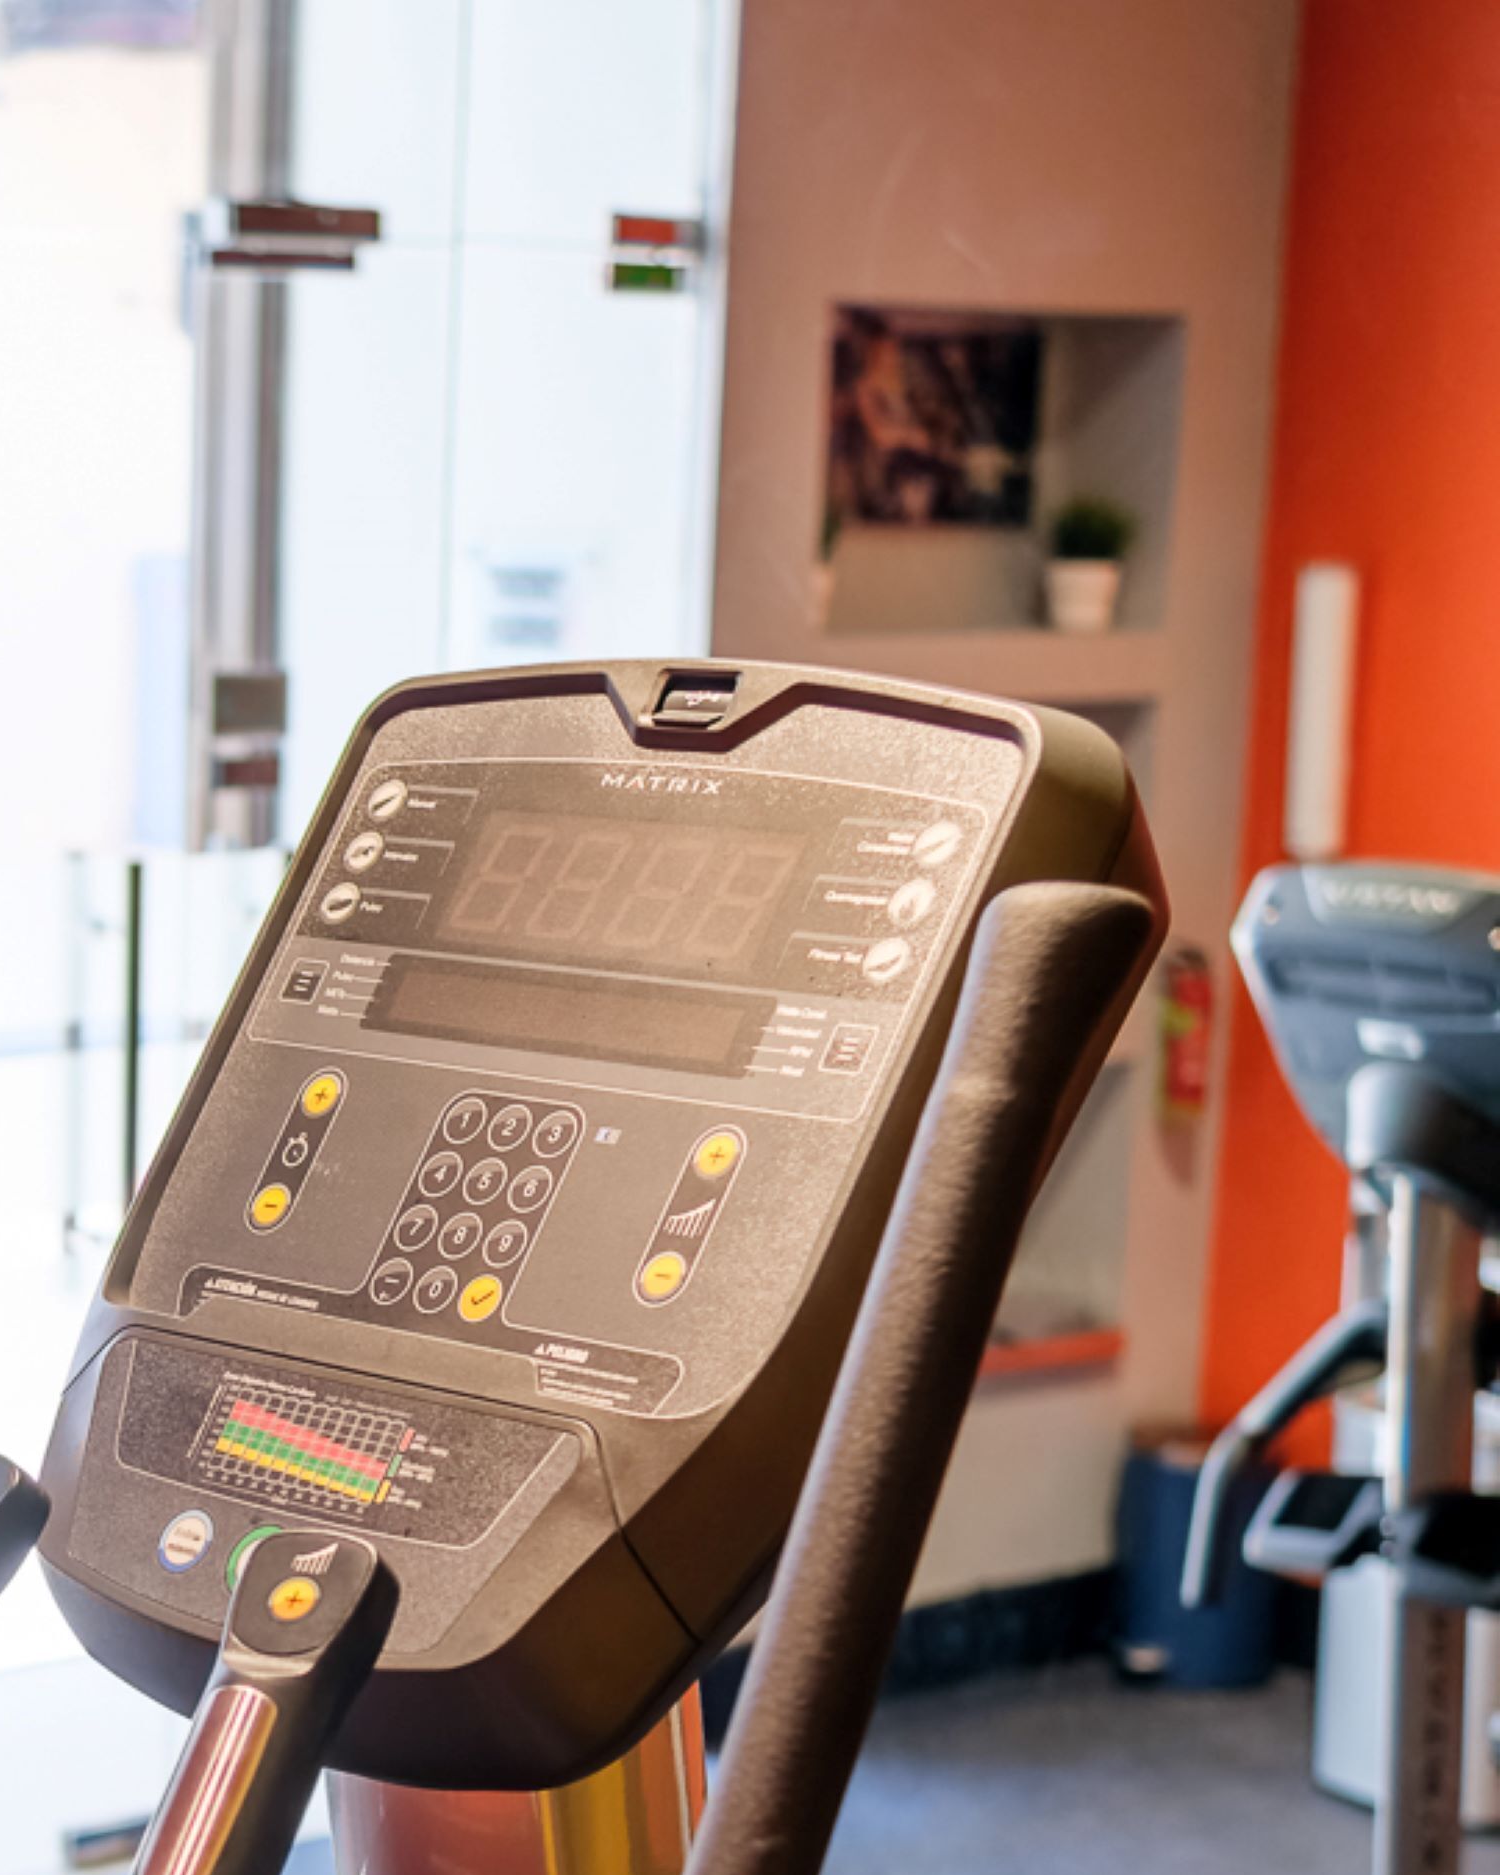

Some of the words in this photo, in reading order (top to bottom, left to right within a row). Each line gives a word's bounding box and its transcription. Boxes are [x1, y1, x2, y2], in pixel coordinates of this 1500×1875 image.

[601, 773, 723, 795] MATRIX
[461, 1112, 471, 1129] 1
[501, 1118, 517, 1136] 2
[547, 1124, 562, 1143] 3
[433, 1165, 447, 1183] 4
[477, 1171, 492, 1190] 5
[523, 1179, 538, 1197] 6
[409, 1218, 424, 1236] 7
[453, 1226, 467, 1244] 8
[499, 1234, 513, 1252] 9
